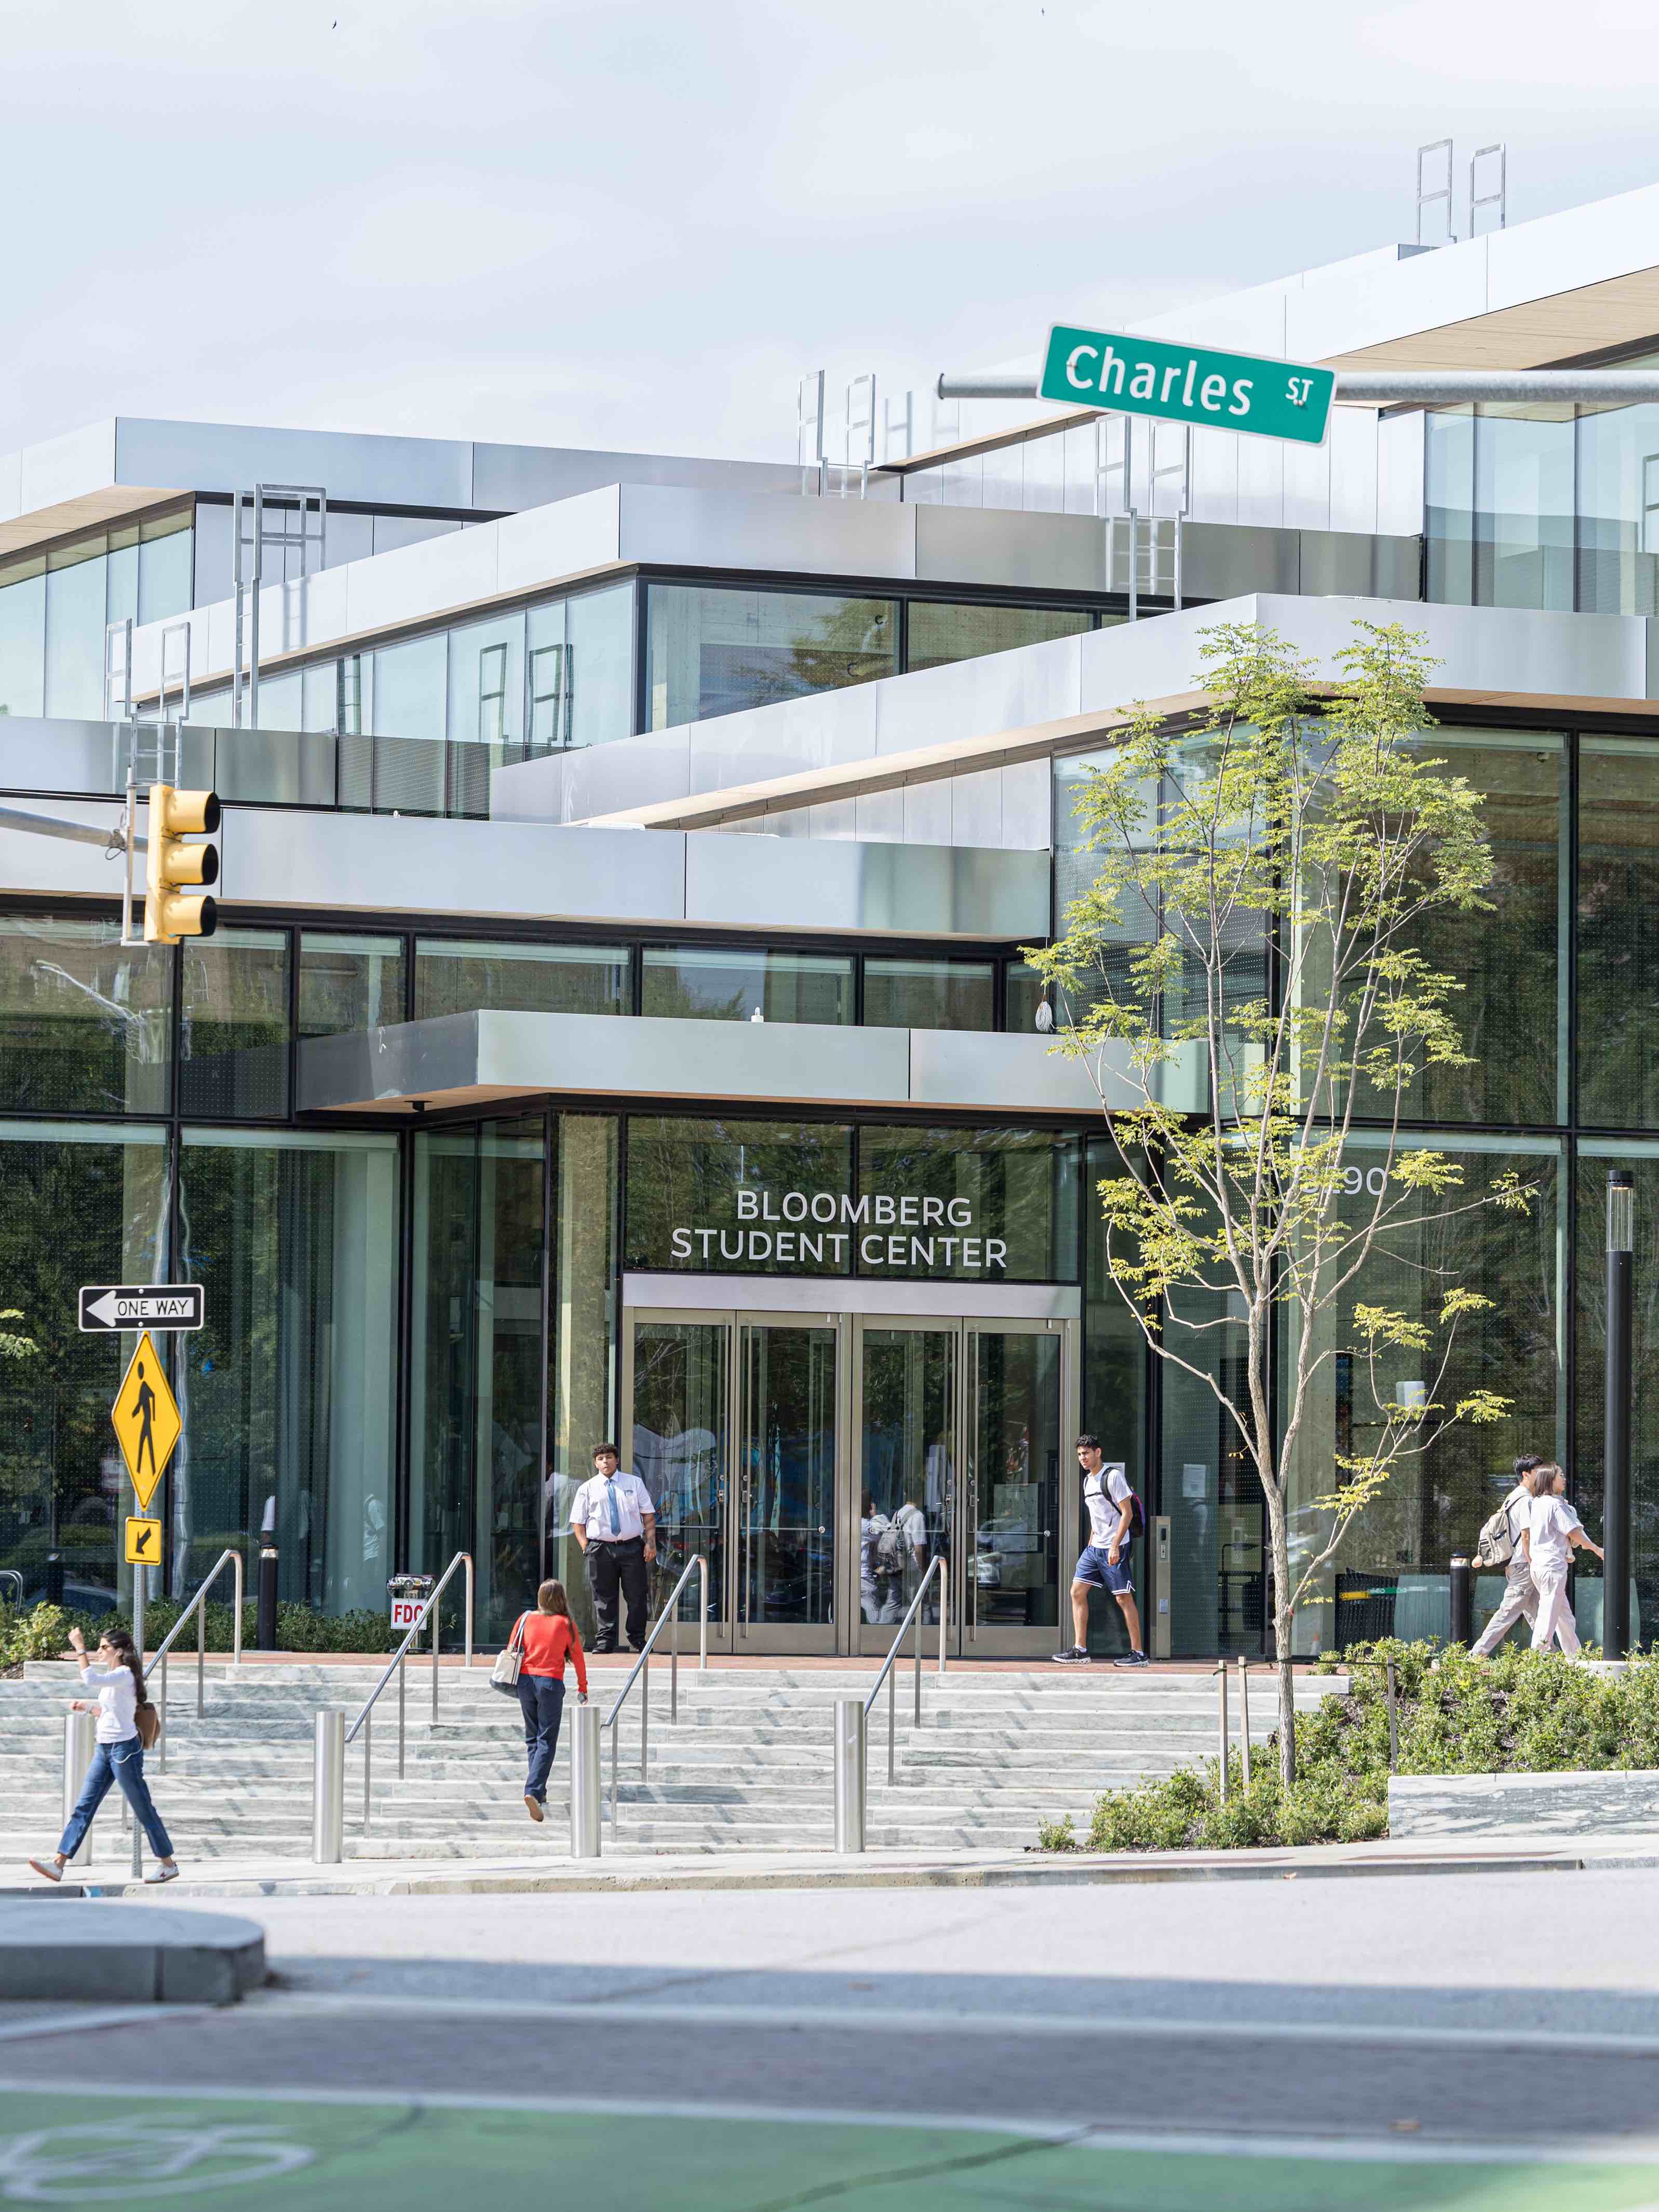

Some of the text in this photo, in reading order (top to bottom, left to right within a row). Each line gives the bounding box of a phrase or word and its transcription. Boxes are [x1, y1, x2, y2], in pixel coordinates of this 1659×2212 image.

[1065, 345, 1313, 415] Charles ST
[1300, 1165, 1387, 1195] 90
[737, 1190, 972, 1226] BLOOMBERG
[671, 1229, 1007, 1267] STUDENT CENTER
[118, 1300, 188, 1316] ONE WAY
